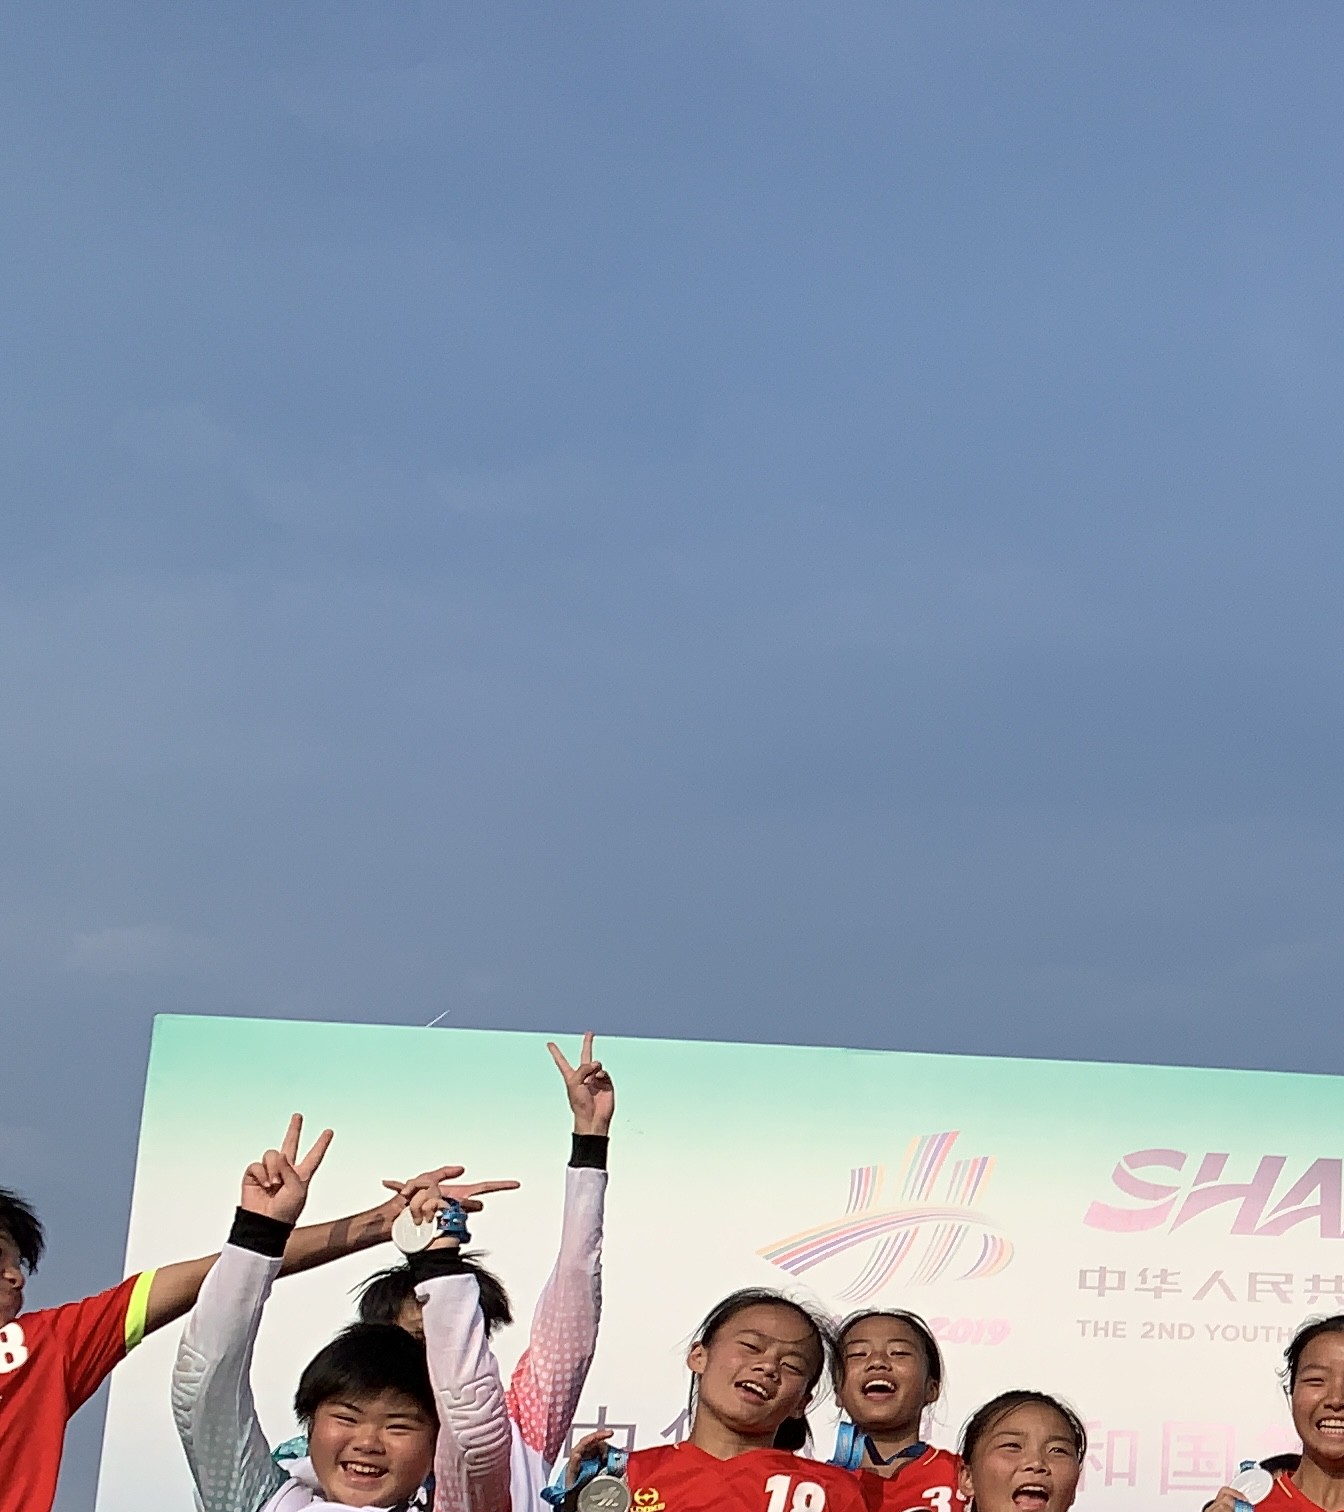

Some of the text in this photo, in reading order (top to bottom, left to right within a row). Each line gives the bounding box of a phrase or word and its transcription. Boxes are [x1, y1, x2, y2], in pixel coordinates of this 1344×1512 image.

[1076, 1319, 1127, 1339] THE
[1140, 1321, 1196, 1341] 2ND
[1205, 1323, 1290, 1344] YOUTH
